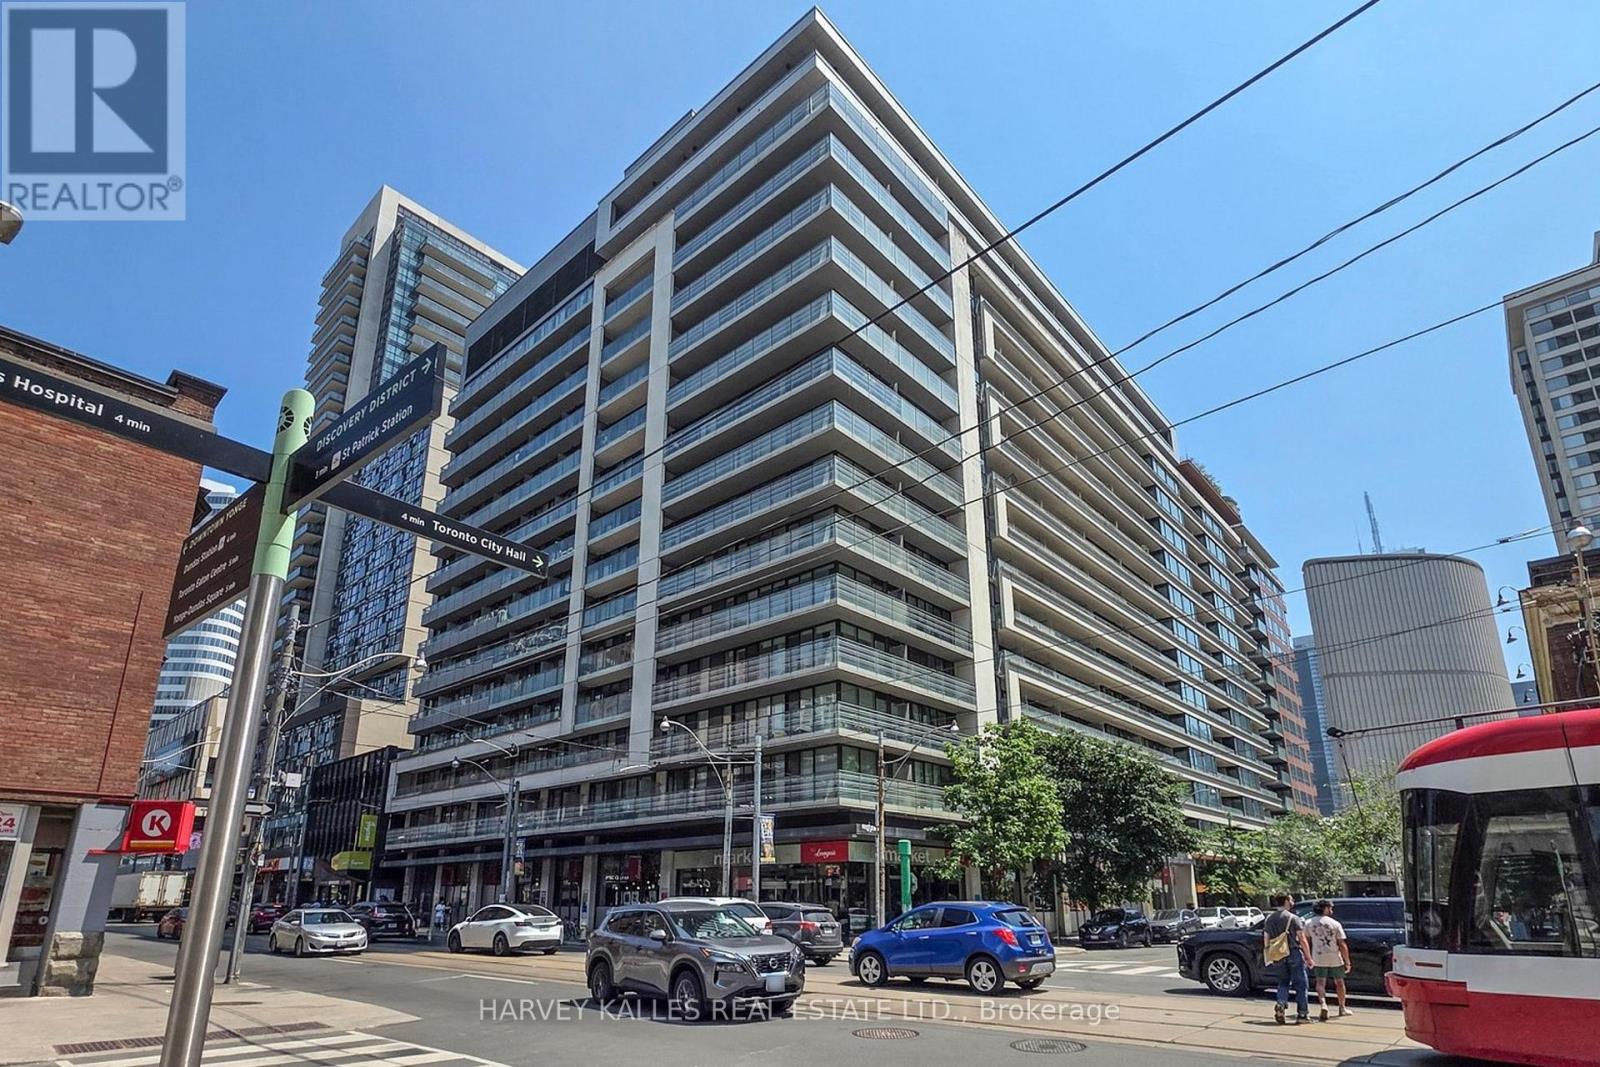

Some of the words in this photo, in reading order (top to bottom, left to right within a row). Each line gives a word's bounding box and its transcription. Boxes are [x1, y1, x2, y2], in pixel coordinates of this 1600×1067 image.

[13, 375, 104, 416] Hospital
[114, 414, 123, 423] 4
[126, 419, 151, 433] min
[316, 406, 367, 452] DISCOVERY
[369, 369, 417, 413] DISTRICT
[342, 445, 350, 460] St
[352, 426, 380, 454] Patrick
[381, 405, 413, 433] Station
[409, 516, 425, 527] min
[433, 520, 478, 545] Toronto
[481, 538, 503, 554] City
[506, 546, 526, 562] Hall
